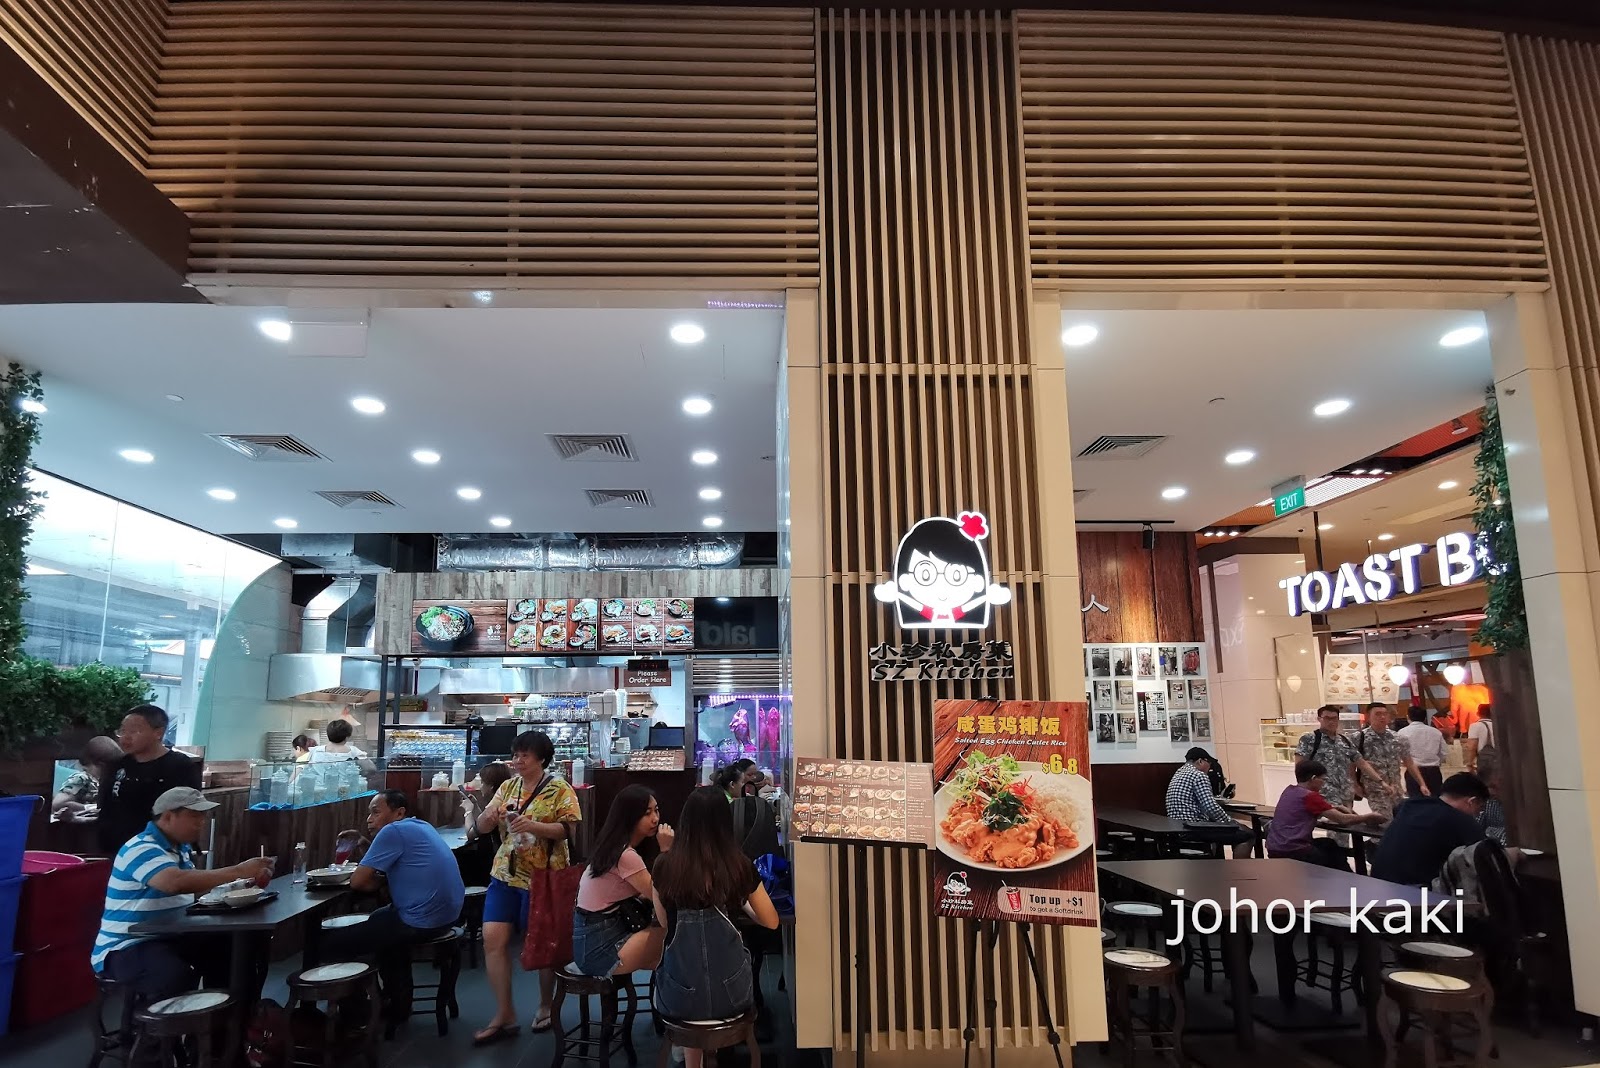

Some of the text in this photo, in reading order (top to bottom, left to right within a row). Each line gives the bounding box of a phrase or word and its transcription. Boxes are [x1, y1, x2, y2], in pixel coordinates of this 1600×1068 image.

[1280, 492, 1298, 511] EXIT
[1278, 542, 1428, 617] TOAST
[869, 640, 1014, 661] 小珍私房菜
[628, 676, 649, 684] Order
[872, 662, 1014, 681] SZ Kitchen
[956, 715, 1061, 736] 咸蛋鸡排饭
[980, 737, 996, 746] Egg
[996, 738, 1026, 746] Chicken
[1041, 753, 1079, 776] $6.8
[1029, 894, 1046, 905] Top
[1049, 897, 1061, 906] up
[1066, 896, 1083, 907] +$1
